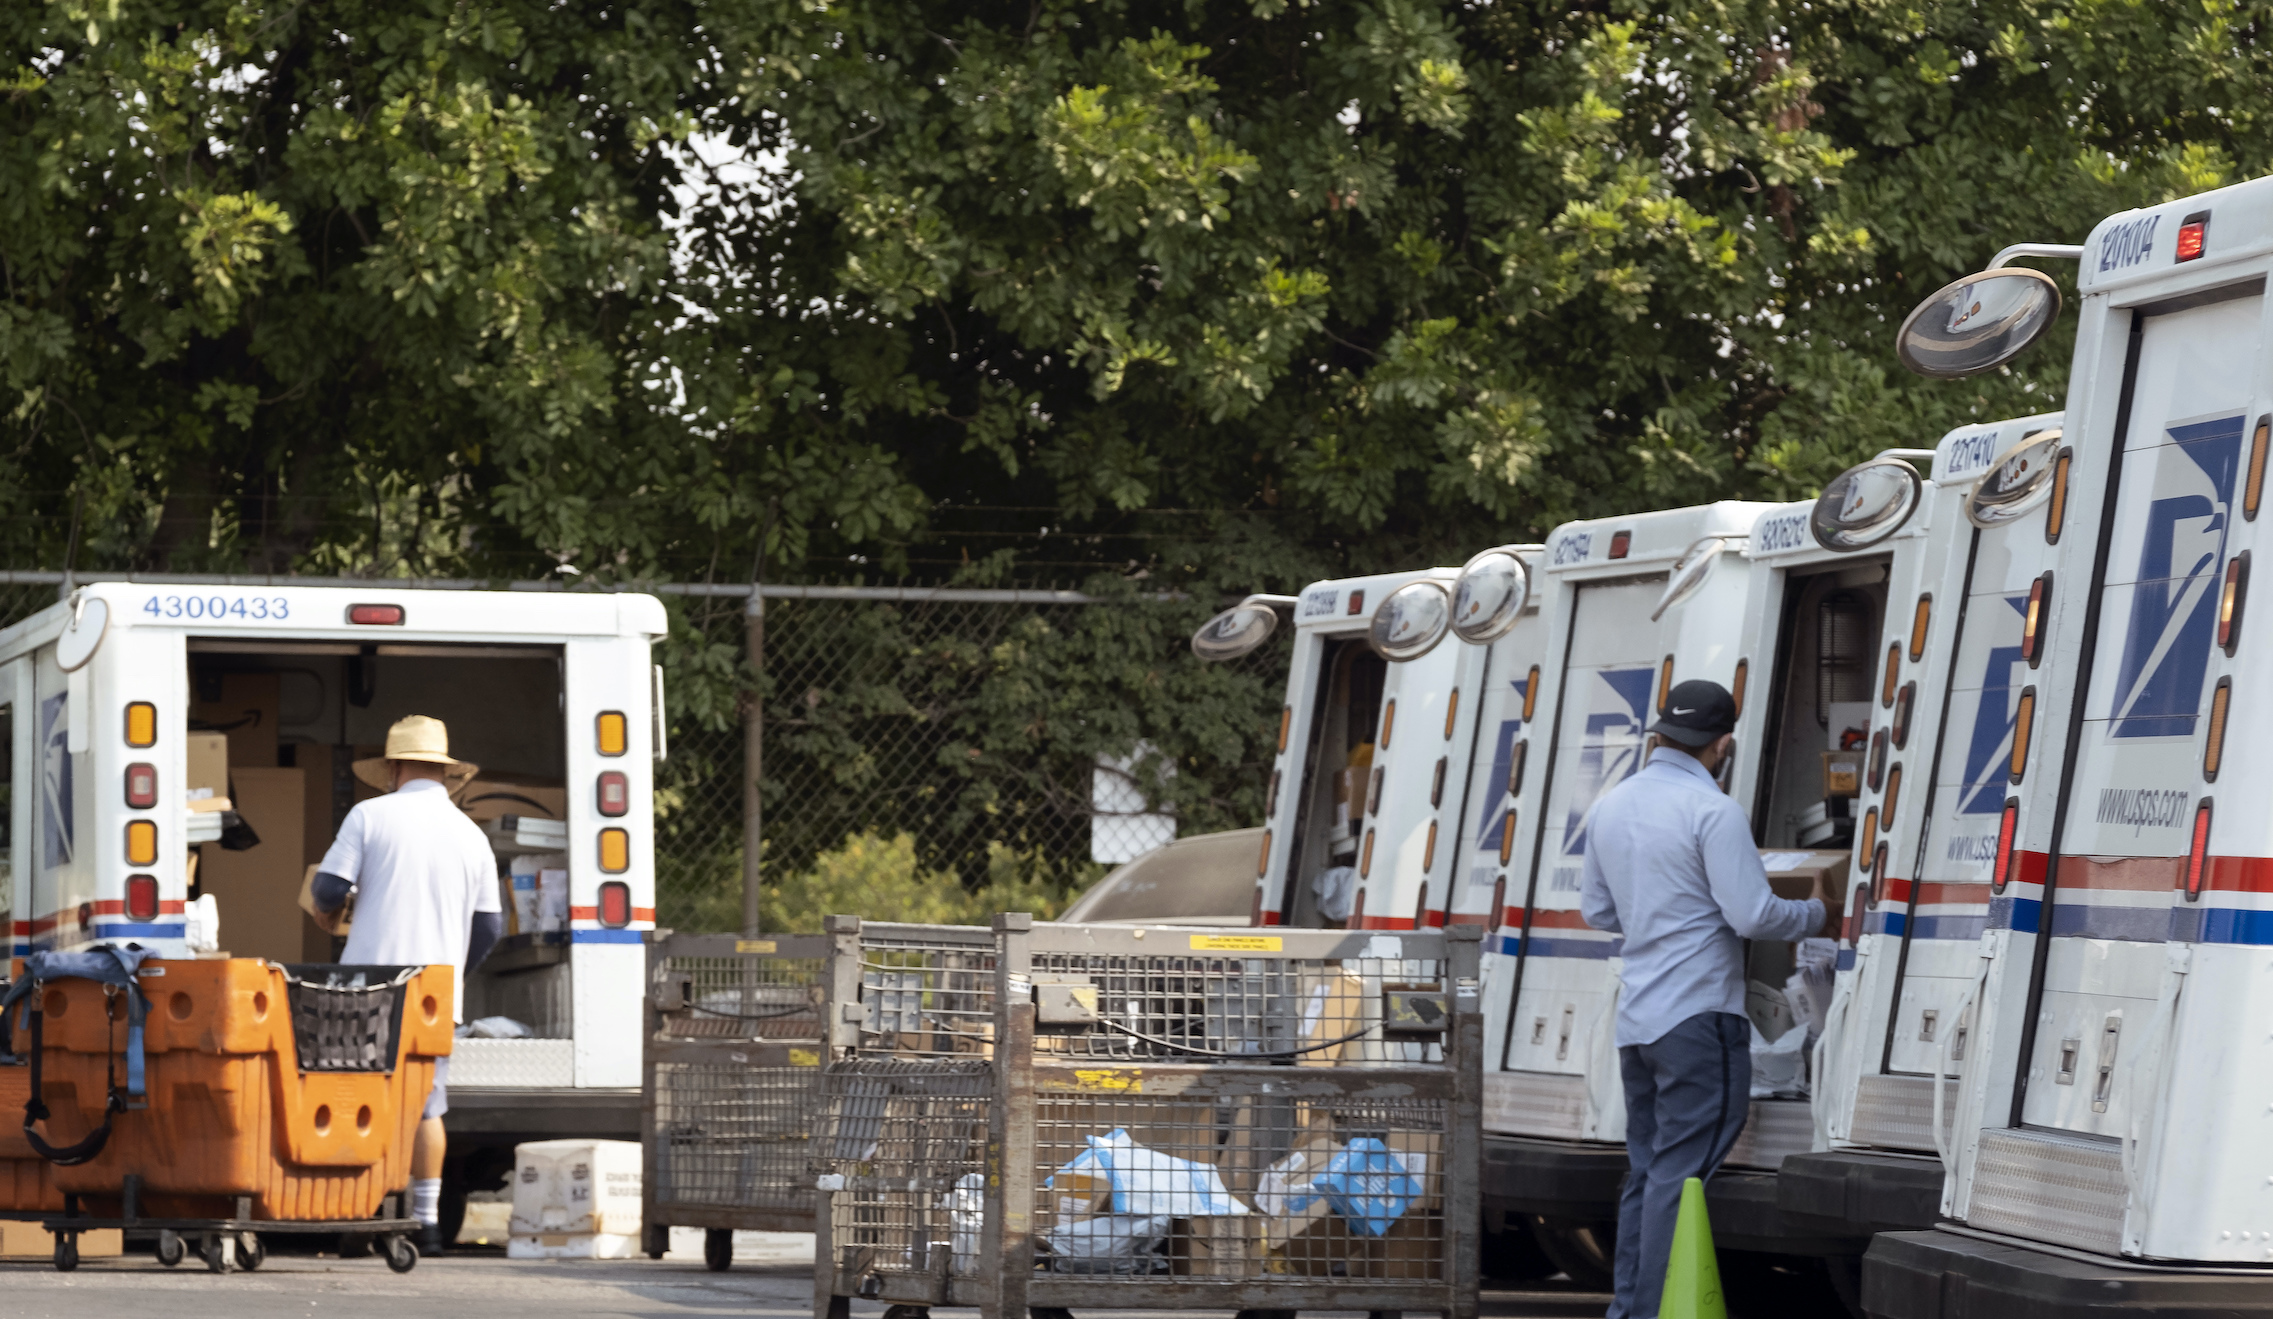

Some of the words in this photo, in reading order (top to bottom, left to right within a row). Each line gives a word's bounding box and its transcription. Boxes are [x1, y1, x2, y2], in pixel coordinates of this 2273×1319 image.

[2099, 214, 2161, 273] 1201004
[143, 595, 290, 620] 4300433
[2096, 788, 2188, 838] www.usps.com
